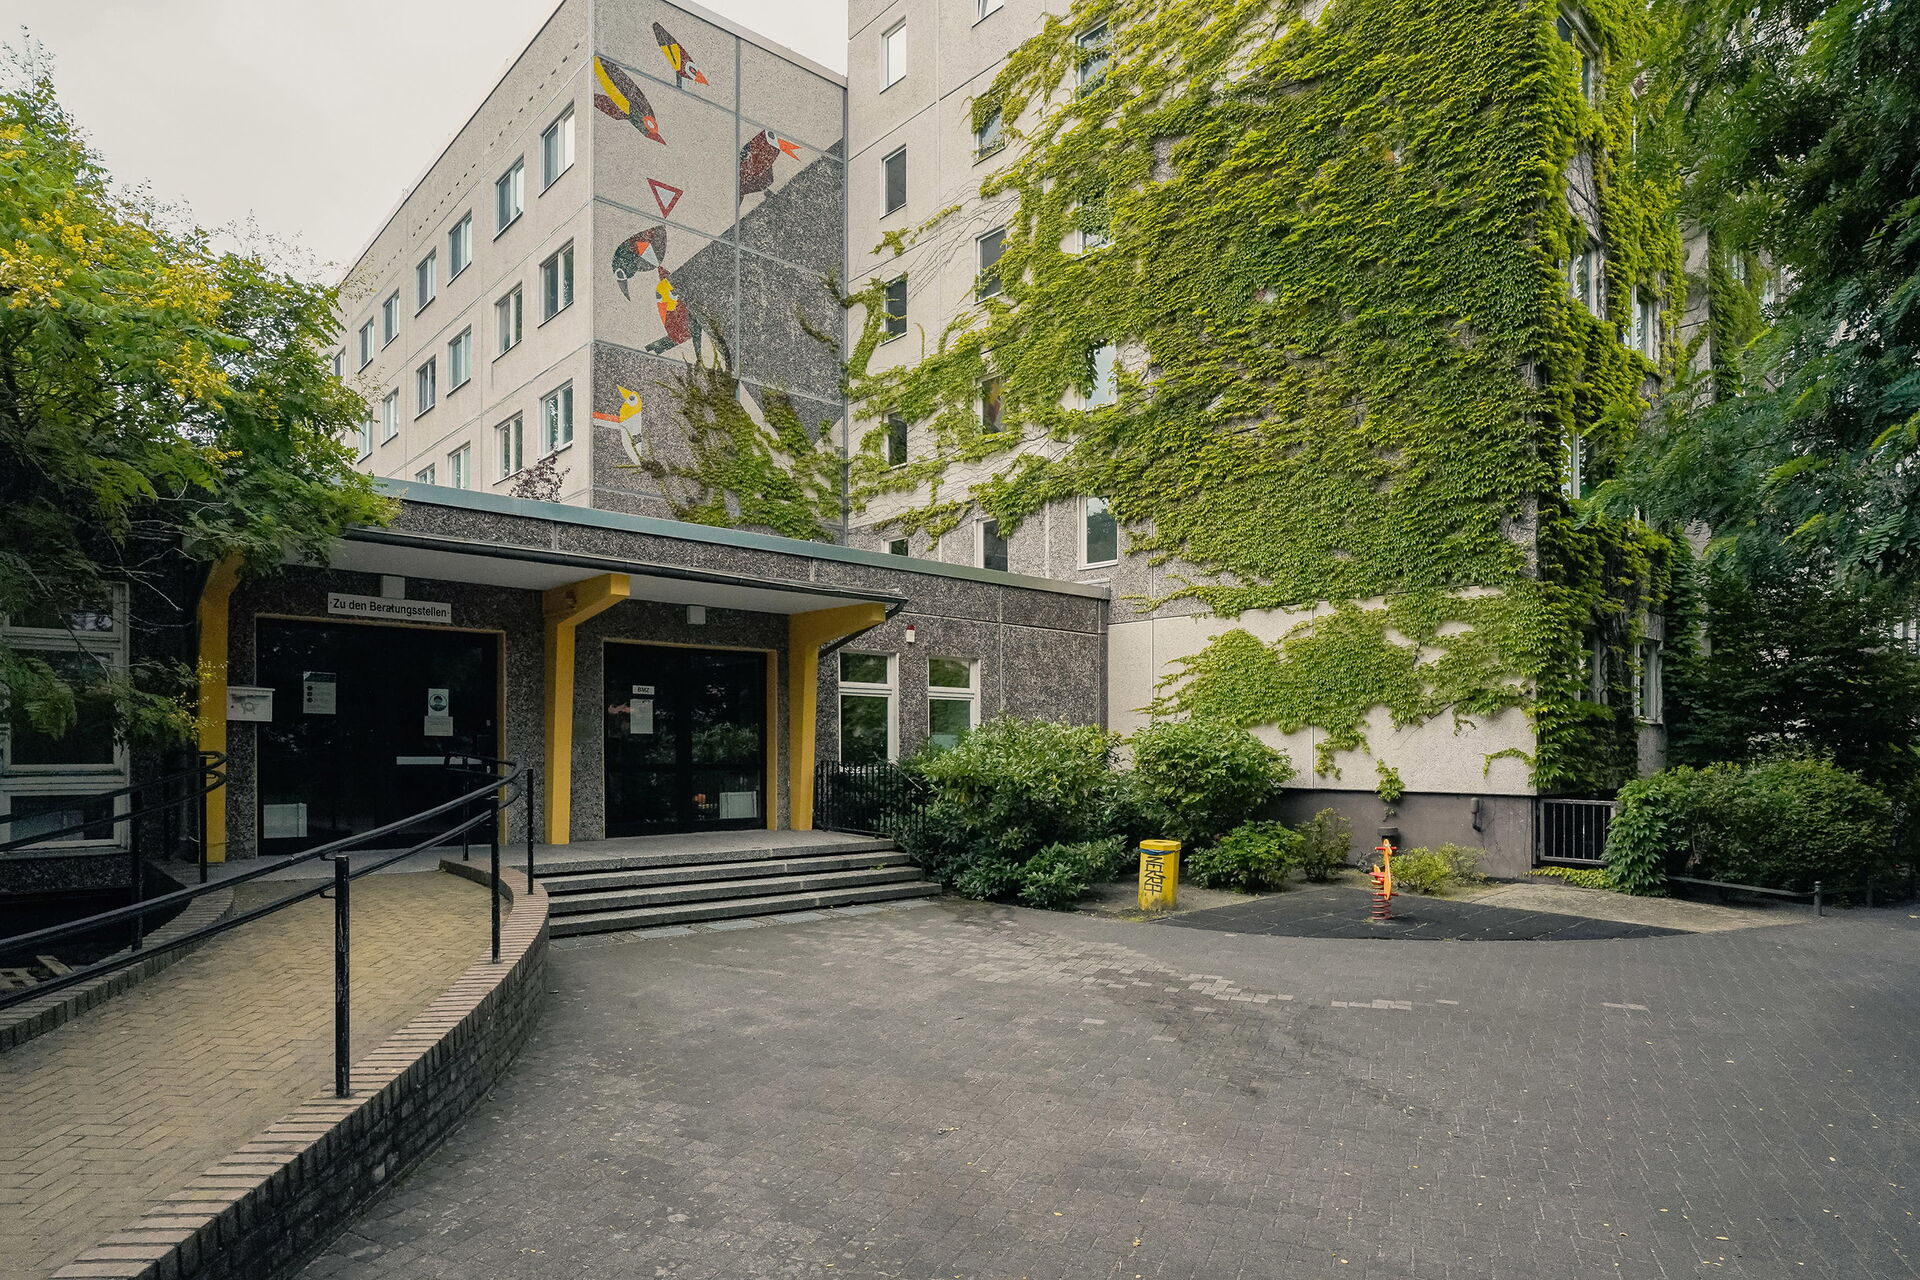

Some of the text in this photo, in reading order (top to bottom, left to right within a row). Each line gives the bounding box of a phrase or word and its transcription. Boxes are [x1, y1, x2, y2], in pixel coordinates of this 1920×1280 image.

[333, 598, 447, 617] Zu den Beratungsstellen
